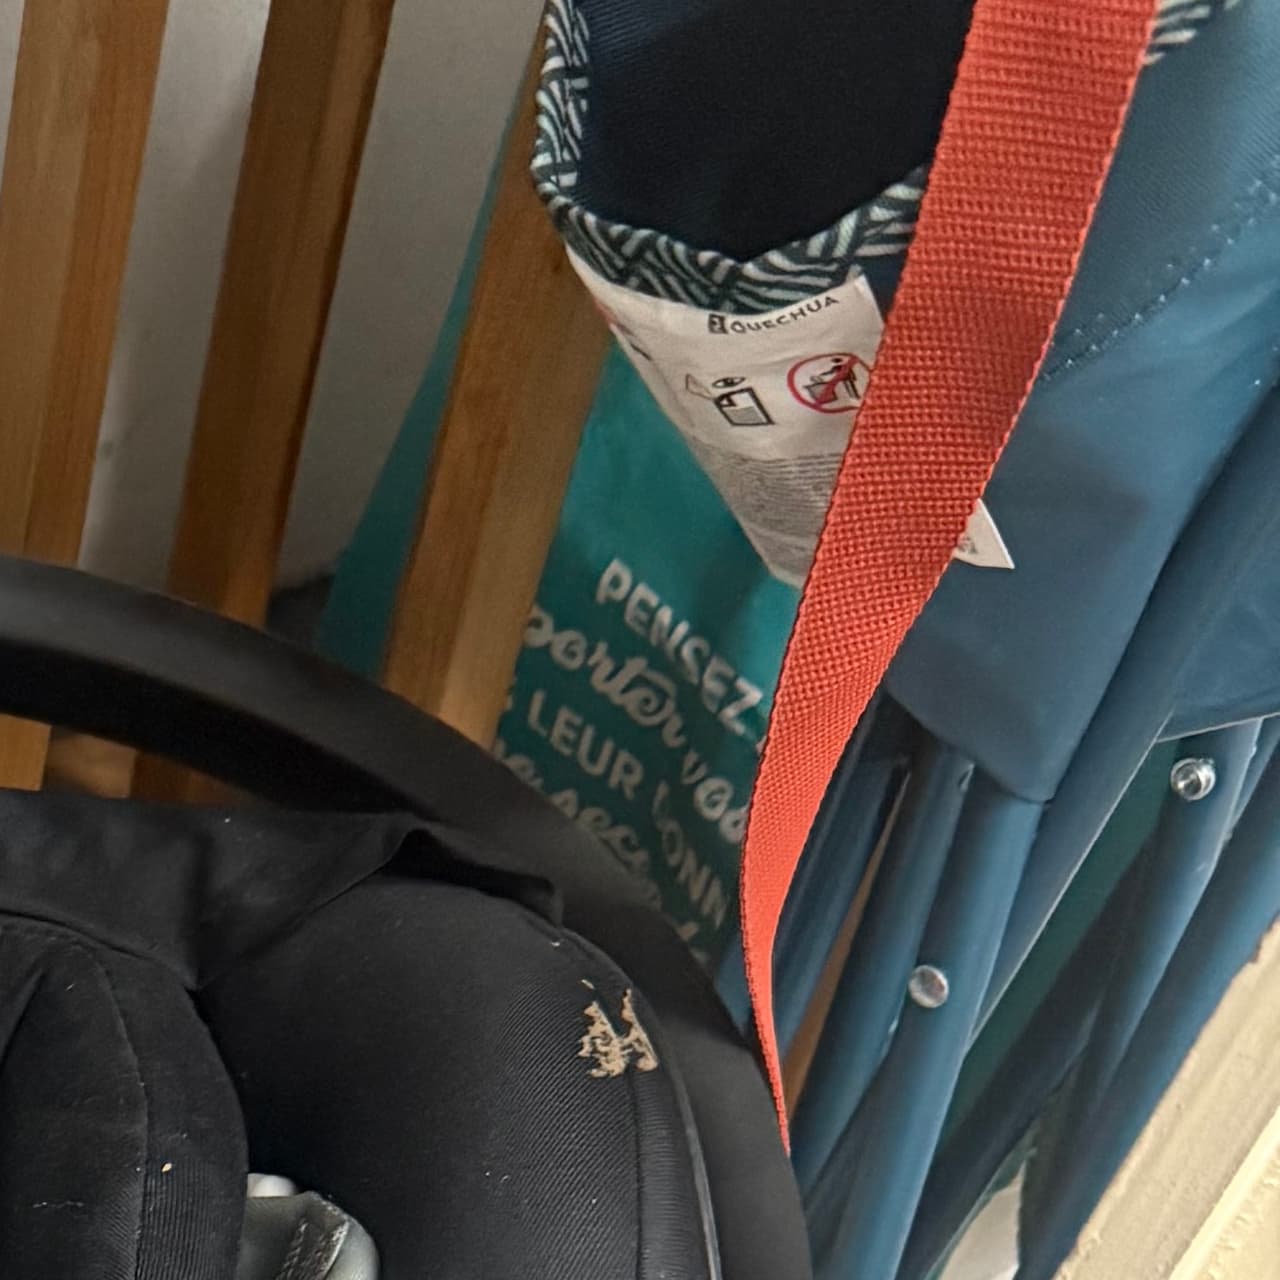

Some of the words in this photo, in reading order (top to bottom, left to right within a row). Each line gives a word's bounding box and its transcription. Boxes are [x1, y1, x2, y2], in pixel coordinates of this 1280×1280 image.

[729, 295, 840, 334] QUECHUA
[595, 556, 764, 736] PENSEZ
[527, 689, 645, 800] LEUR
